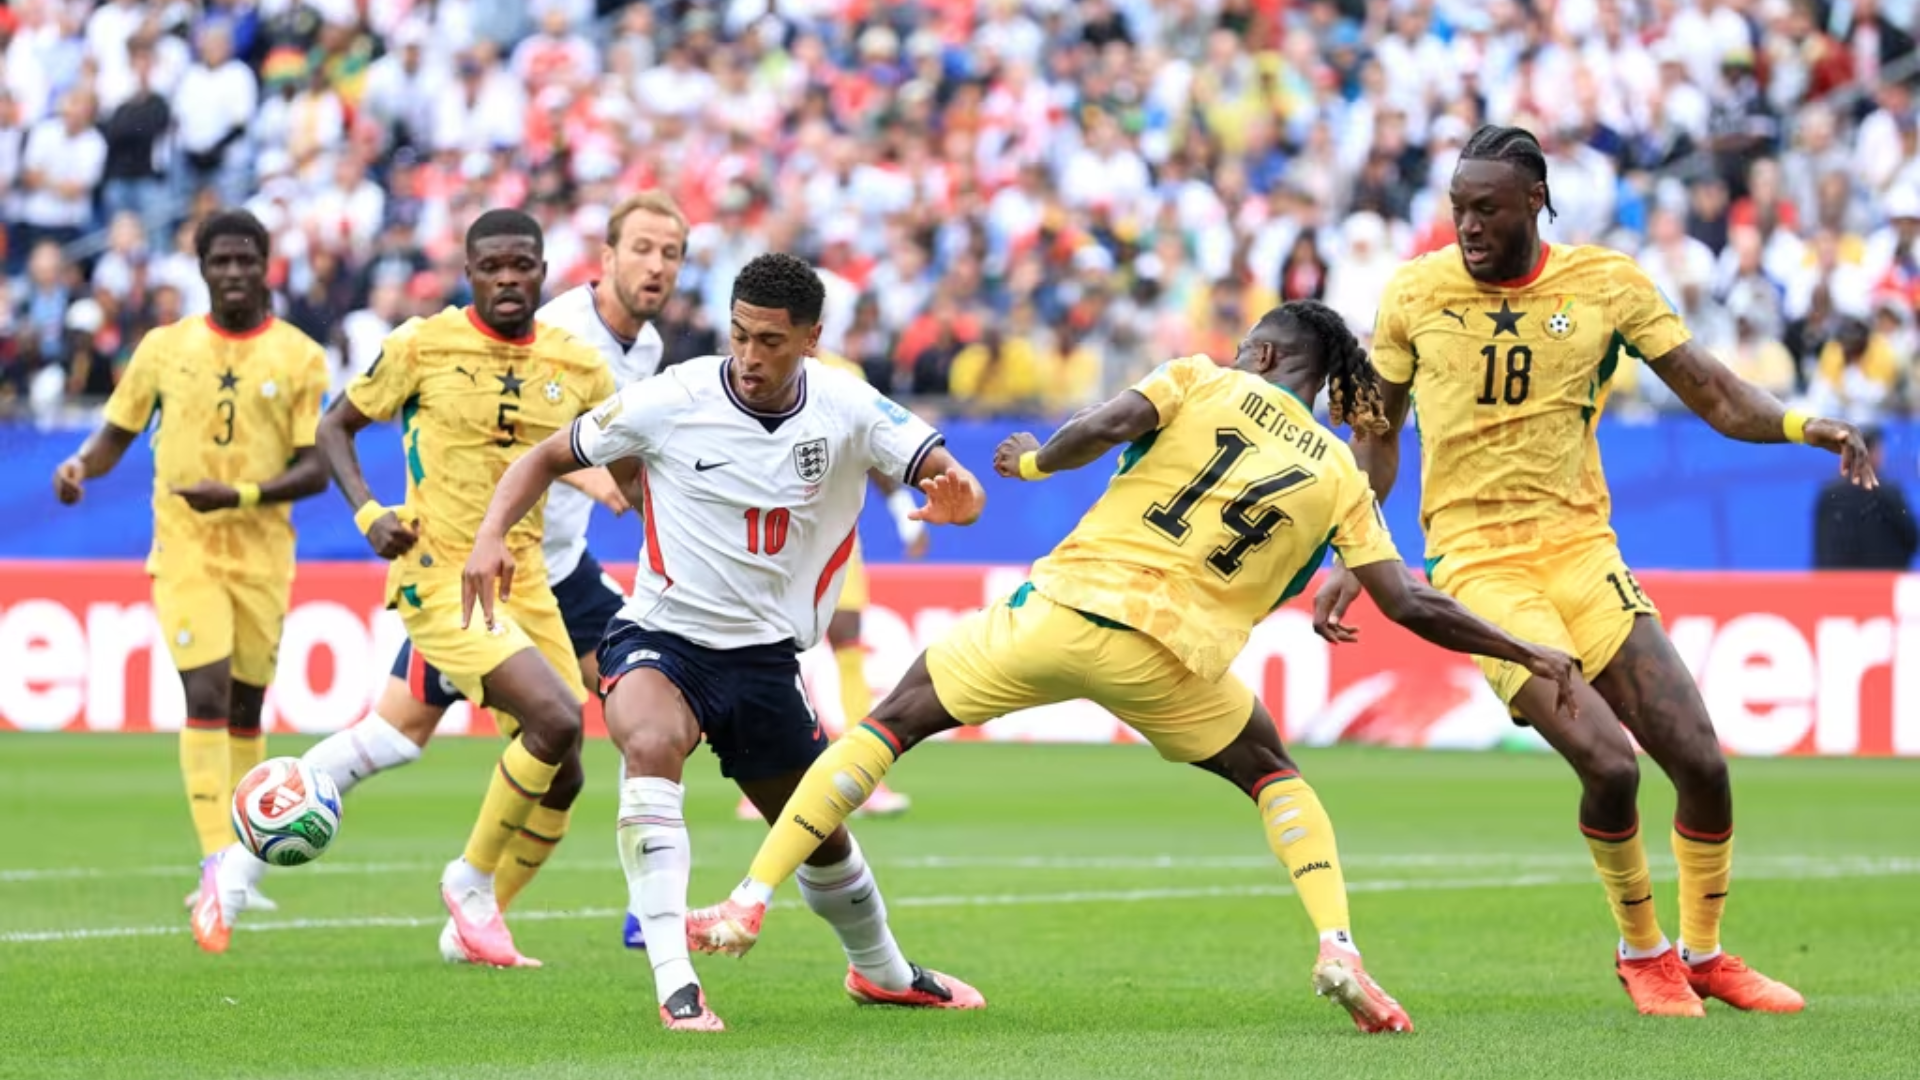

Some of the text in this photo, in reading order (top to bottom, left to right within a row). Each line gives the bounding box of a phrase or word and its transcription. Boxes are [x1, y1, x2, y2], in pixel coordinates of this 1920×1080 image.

[1476, 344, 1532, 406] 18
[213, 399, 235, 447] 3
[496, 402, 520, 449] 5
[1239, 391, 1329, 461] MENSAH
[744, 506, 791, 557] 10
[1143, 428, 1317, 582] 14
